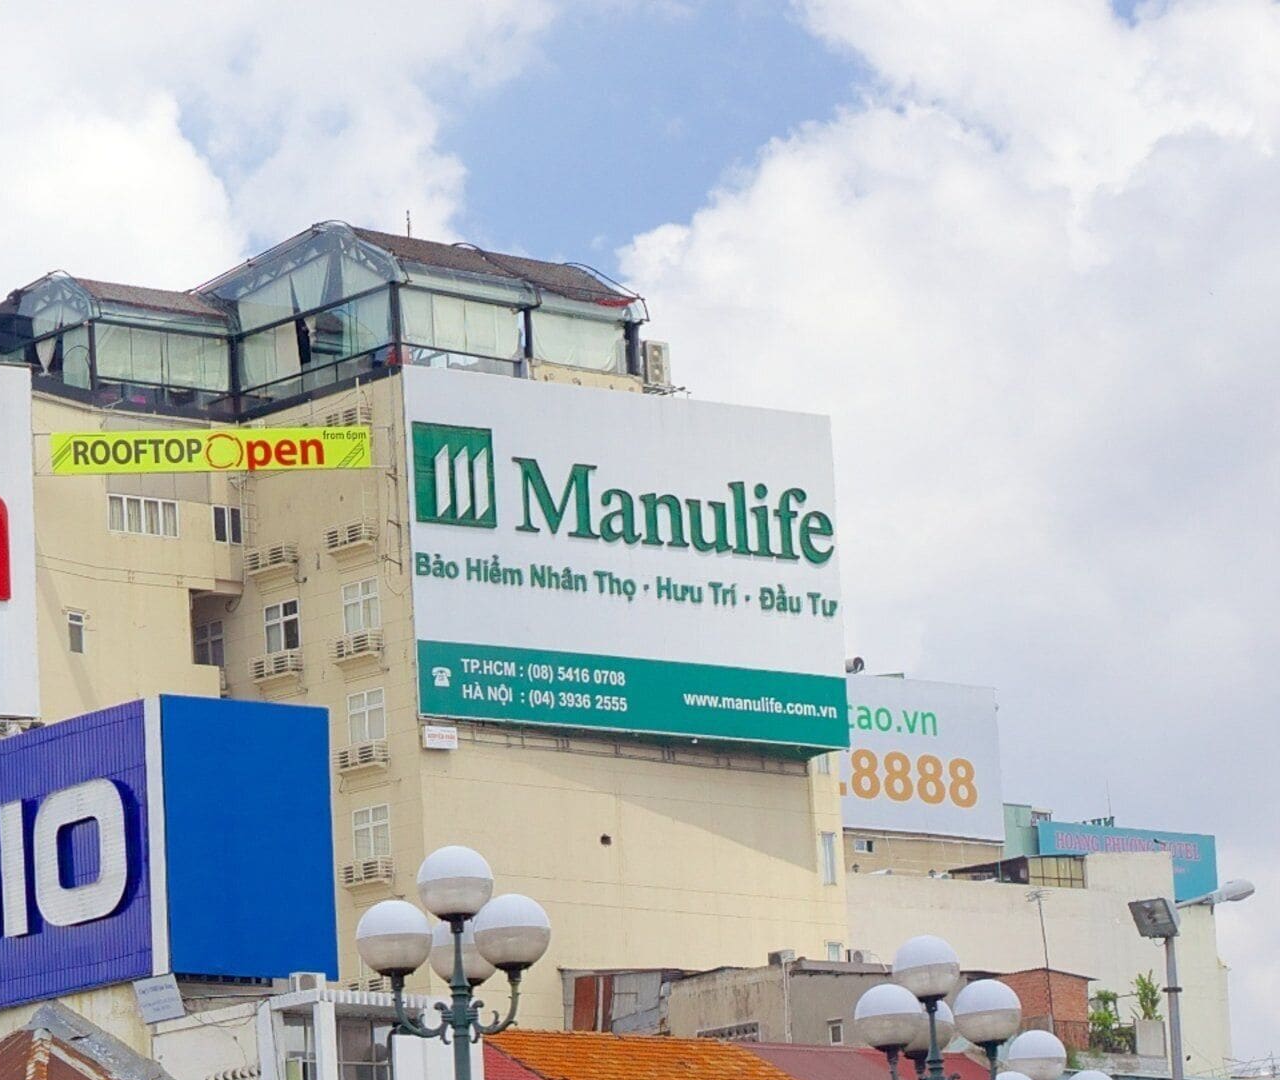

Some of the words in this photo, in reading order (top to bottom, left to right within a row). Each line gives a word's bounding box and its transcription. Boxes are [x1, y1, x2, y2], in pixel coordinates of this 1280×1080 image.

[322, 430, 344, 441] from
[346, 430, 367, 442] 6pm
[72, 439, 202, 466] ROOFTOP
[206, 432, 326, 471] Open
[511, 456, 835, 564] Manulife
[415, 551, 459, 579] Bảo
[465, 554, 524, 586] Hiểm
[530, 563, 588, 592] Nhân
[593, 570, 637, 602] Thọ
[656, 576, 702, 603] Hưu
[708, 581, 738, 606] Trí
[758, 583, 801, 613] Đầu
[807, 592, 838, 617] Tư
[460, 658, 516, 677] TP.HCM
[528, 663, 554, 684] (08)
[557, 666, 590, 683] 5416
[593, 669, 626, 686] 0708
[462, 682, 484, 700] HÀ
[488, 684, 513, 706] NỘI
[529, 690, 555, 709] (04)
[558, 692, 591, 709] 3936
[595, 694, 628, 712] 2555
[683, 692, 838, 719] www.manulife.com.vn
